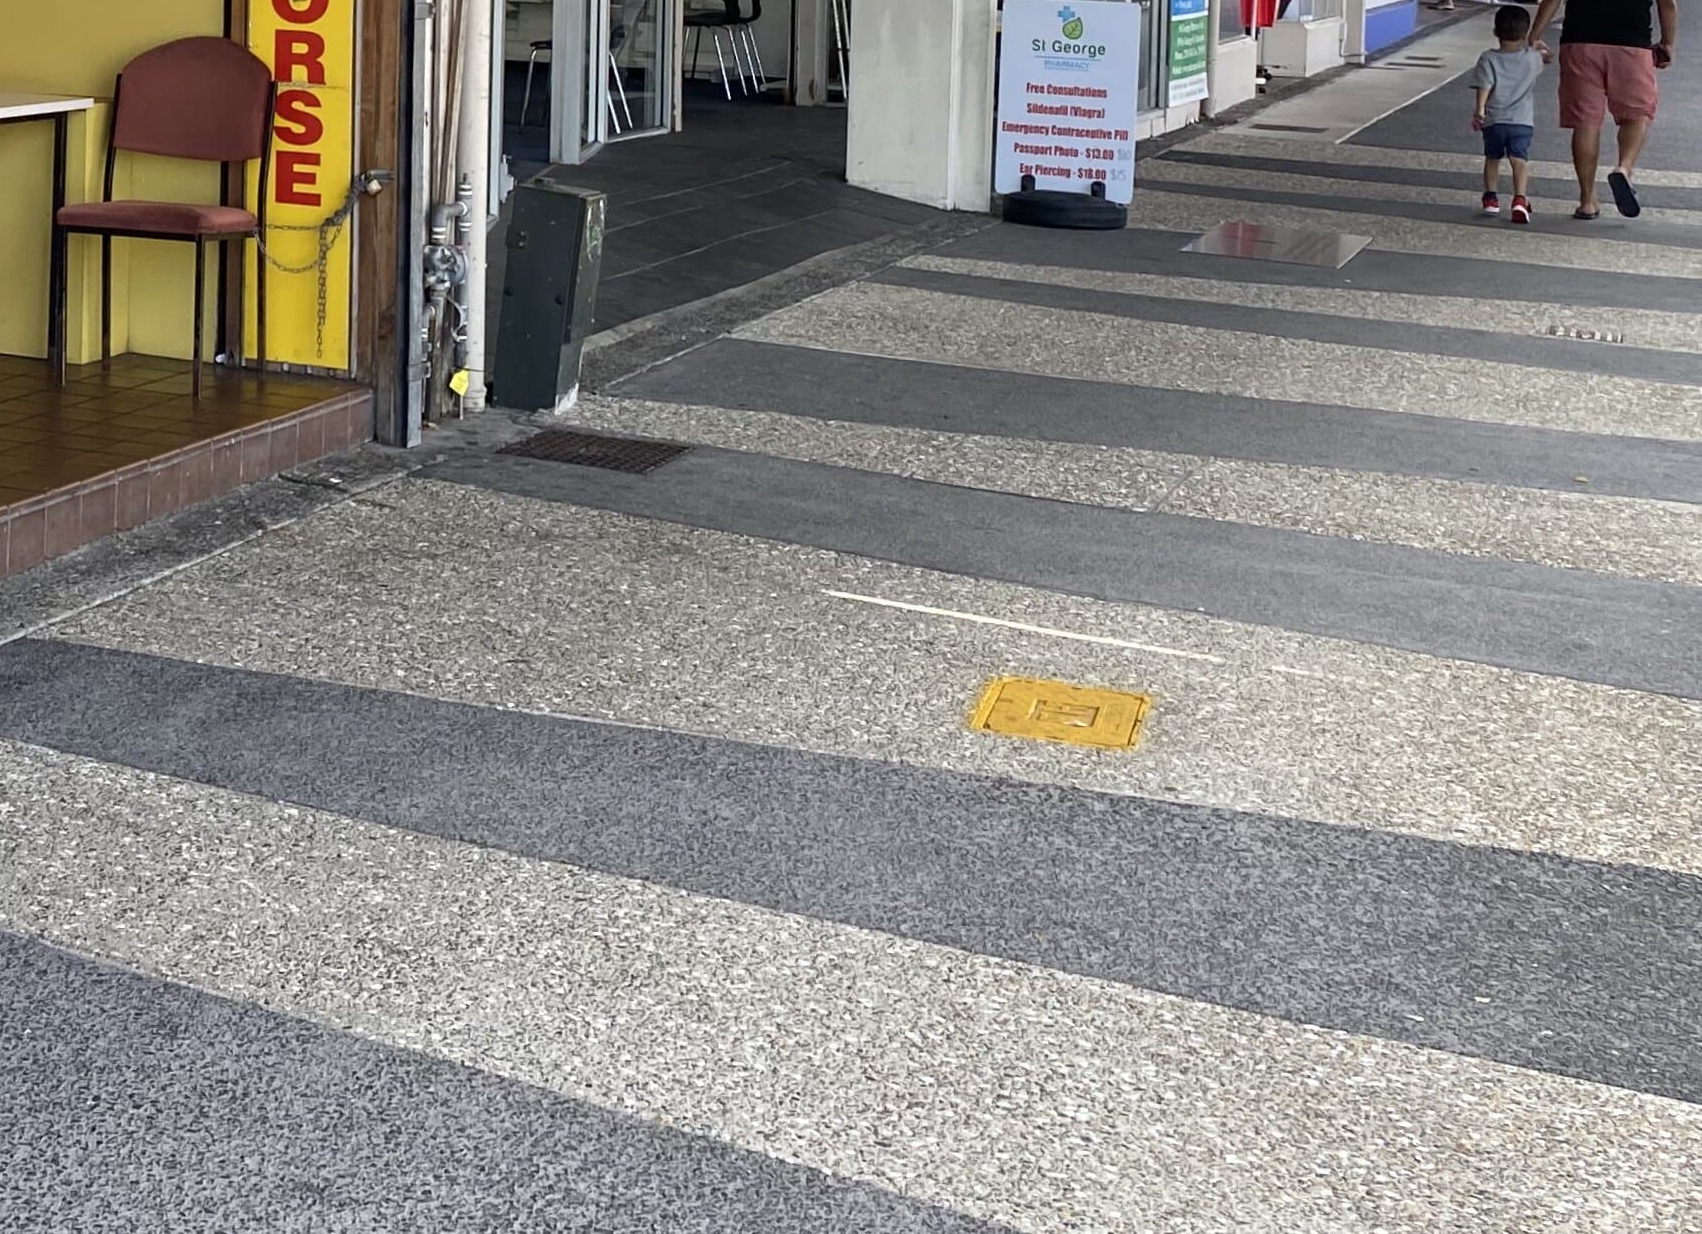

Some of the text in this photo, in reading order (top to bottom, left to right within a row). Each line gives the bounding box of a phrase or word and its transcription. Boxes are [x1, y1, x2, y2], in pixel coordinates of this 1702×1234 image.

[1051, 40, 1106, 58] George
[1026, 82, 1107, 98] Free Consultations
[1027, 103, 1105, 119] Sildenafil (Viagra)
[1002, 121, 1129, 141] Emergency Contraceptive Pill
[1014, 142, 1052, 156] Passport
[1053, 146, 1079, 158] Photo
[1019, 162, 1033, 175] Ear
[1034, 164, 1071, 179] Piercing
